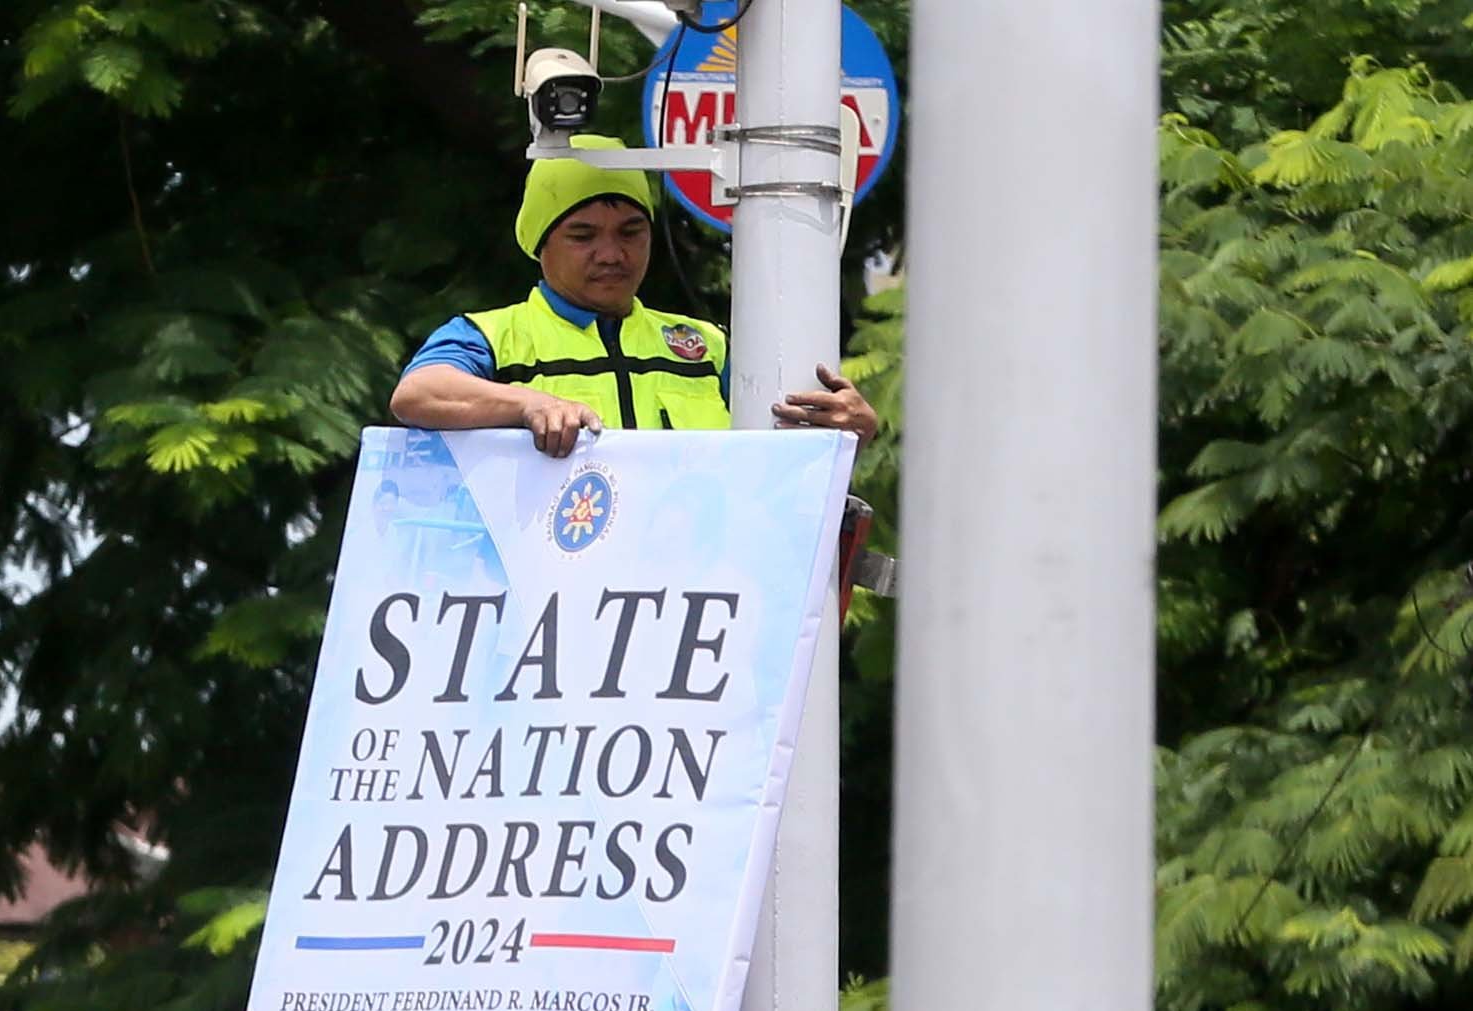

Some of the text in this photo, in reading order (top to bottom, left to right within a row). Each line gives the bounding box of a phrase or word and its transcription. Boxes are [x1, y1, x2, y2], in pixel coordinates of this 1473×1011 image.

[355, 587, 740, 705] STATE
[351, 728, 400, 761] OF
[406, 723, 727, 802] NATION
[330, 768, 400, 802] THE
[303, 820, 694, 903] ADDRESS
[424, 917, 527, 966] 2024
[502, 990, 524, 1011] R.
